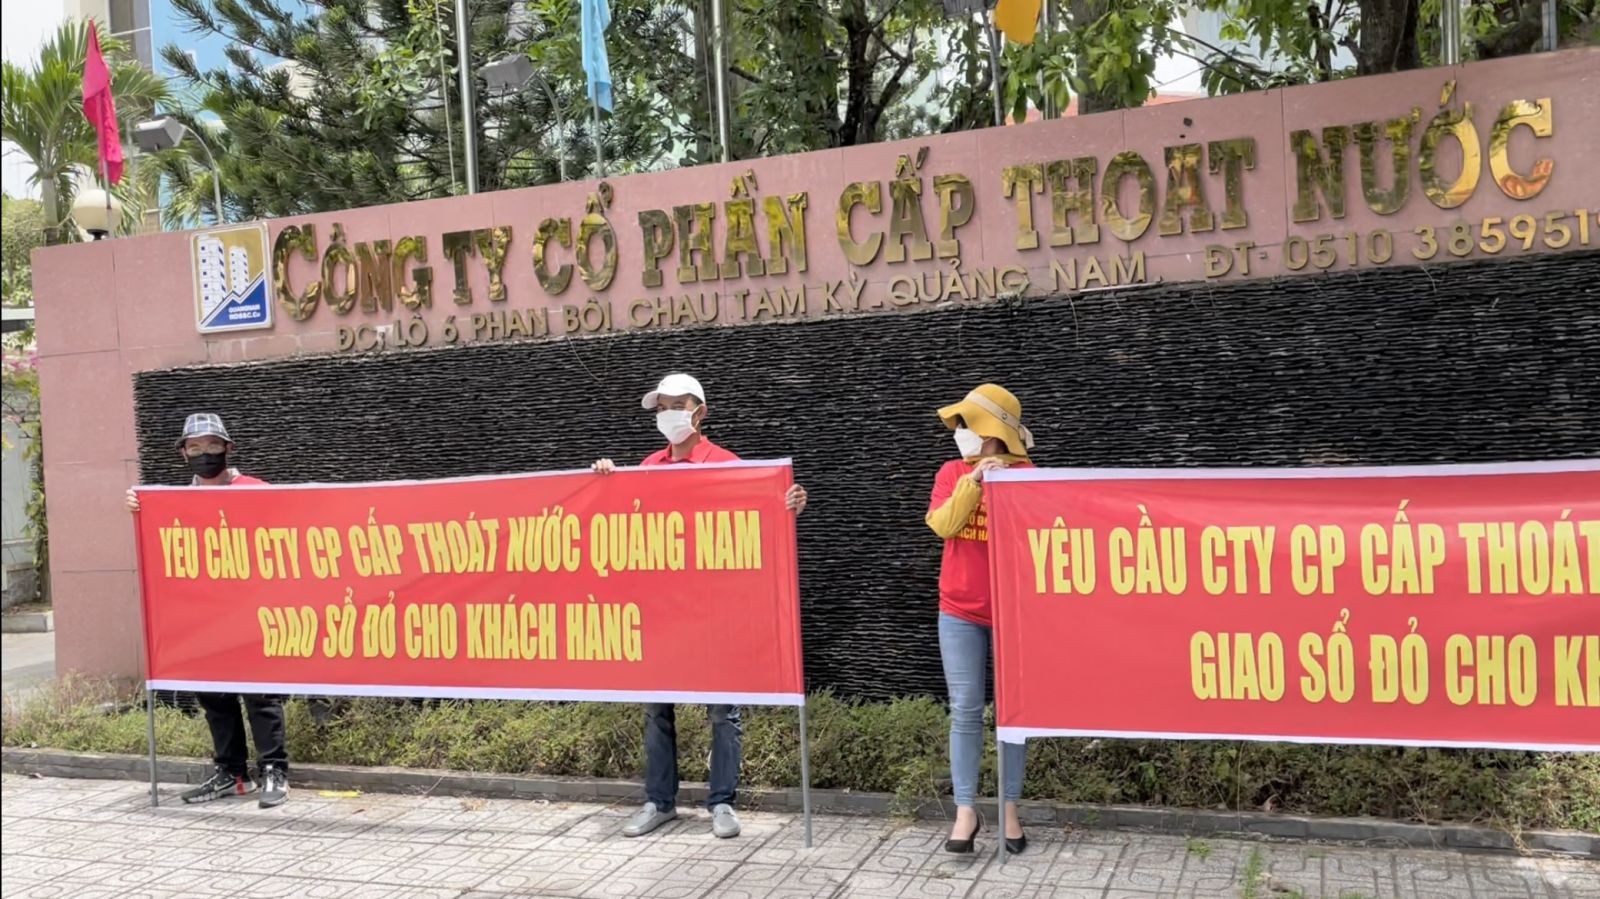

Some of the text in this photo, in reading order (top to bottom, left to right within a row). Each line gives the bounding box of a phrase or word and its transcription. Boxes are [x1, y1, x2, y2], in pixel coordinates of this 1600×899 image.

[273, 222, 434, 321] CÔNG
[442, 224, 513, 305] TY
[532, 181, 619, 296] CỔ
[638, 168, 809, 288] PHẦN
[836, 146, 976, 267] CẤP
[1289, 79, 1554, 223] NƯỚC
[392, 312, 430, 347] LÔ
[470, 307, 550, 341] PHAN
[734, 283, 807, 320] TAM
[1283, 229, 1393, 271] 0510
[1412, 208, 1600, 260] 385951
[159, 498, 763, 580] YÊU CẦU CTY CP CẤP THOÁT NƯỚC QUẢNG NAM
[1027, 499, 1600, 595] YÊU CẦU CTY CP CẤP THOÁT
[257, 586, 643, 662] GIAO SỔ ĐỎ CHO KHÁCH HÀNG
[1190, 630, 1286, 702] GIAO
[1298, 607, 1356, 703] SỔ
[1368, 616, 1430, 705] ĐỎ
[1445, 633, 1539, 706] CHO
